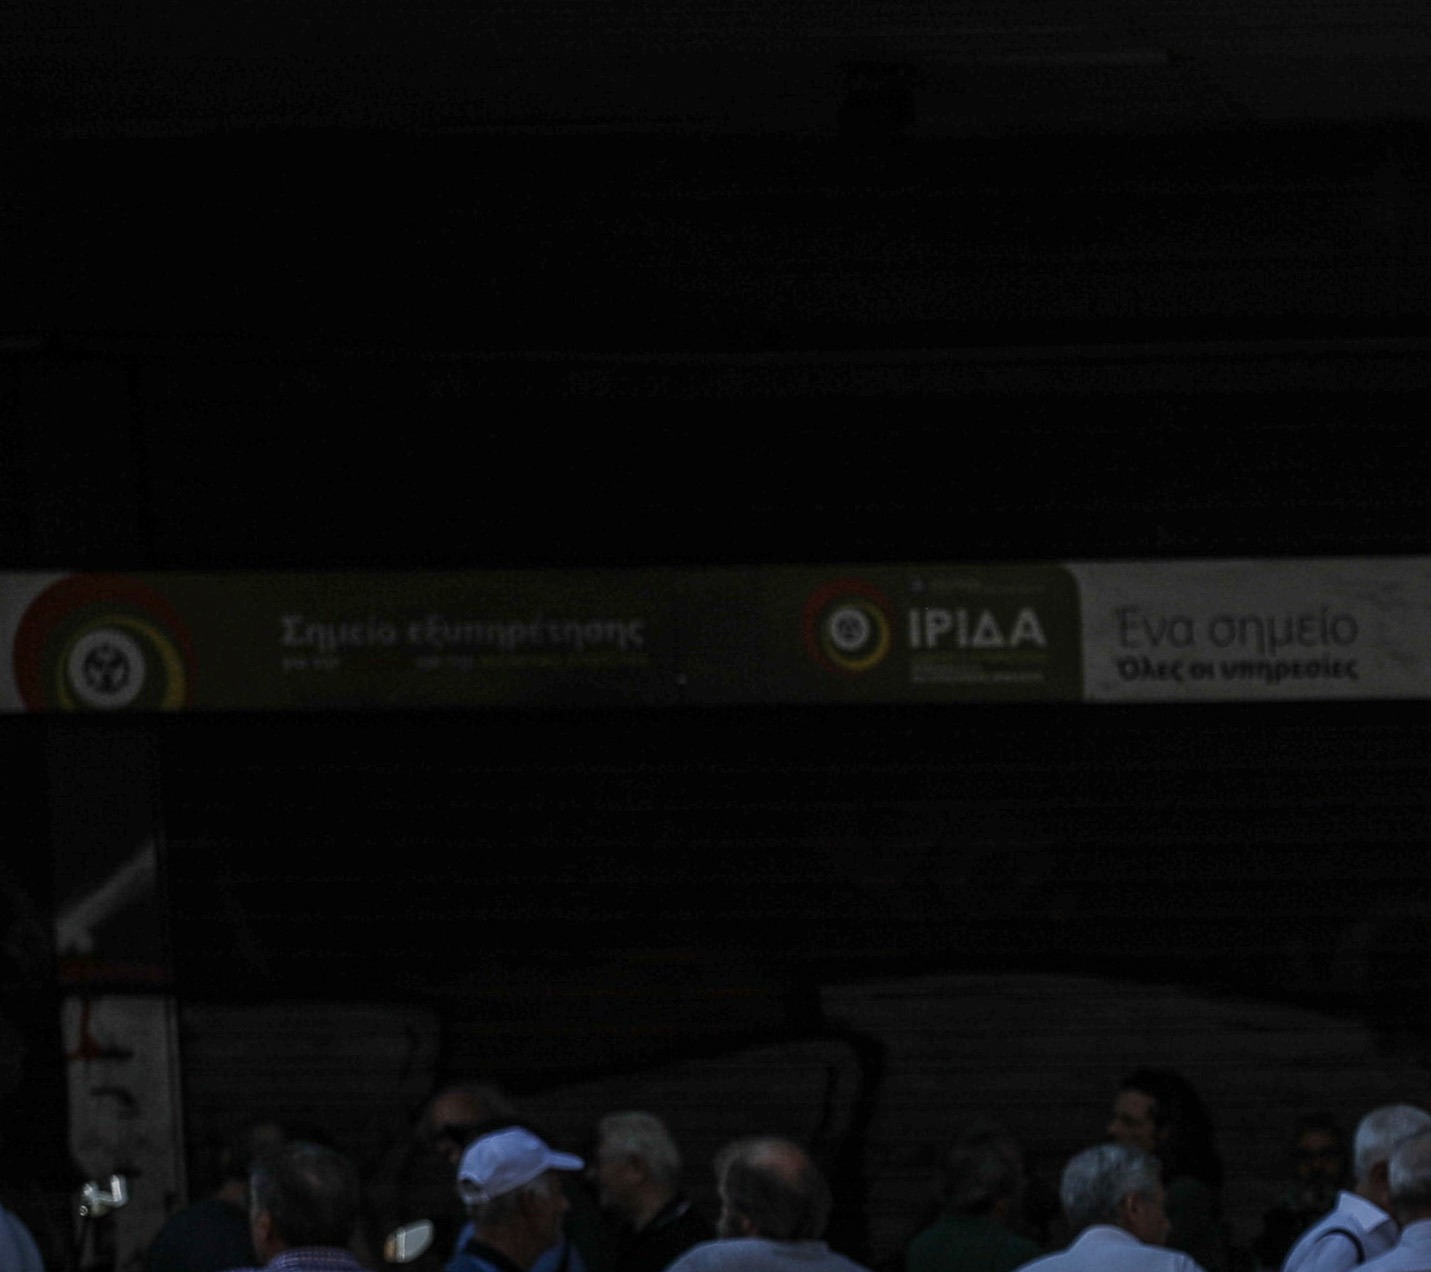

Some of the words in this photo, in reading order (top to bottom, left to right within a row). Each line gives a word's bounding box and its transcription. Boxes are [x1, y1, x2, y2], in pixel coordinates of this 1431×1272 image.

[280, 613, 397, 650] Σημείο
[908, 606, 1048, 649] ΙΡΙΔΑ
[1207, 603, 1359, 656] σημείο
[1188, 657, 1214, 682] οι
[1219, 650, 1359, 686] υπηρεσίες
